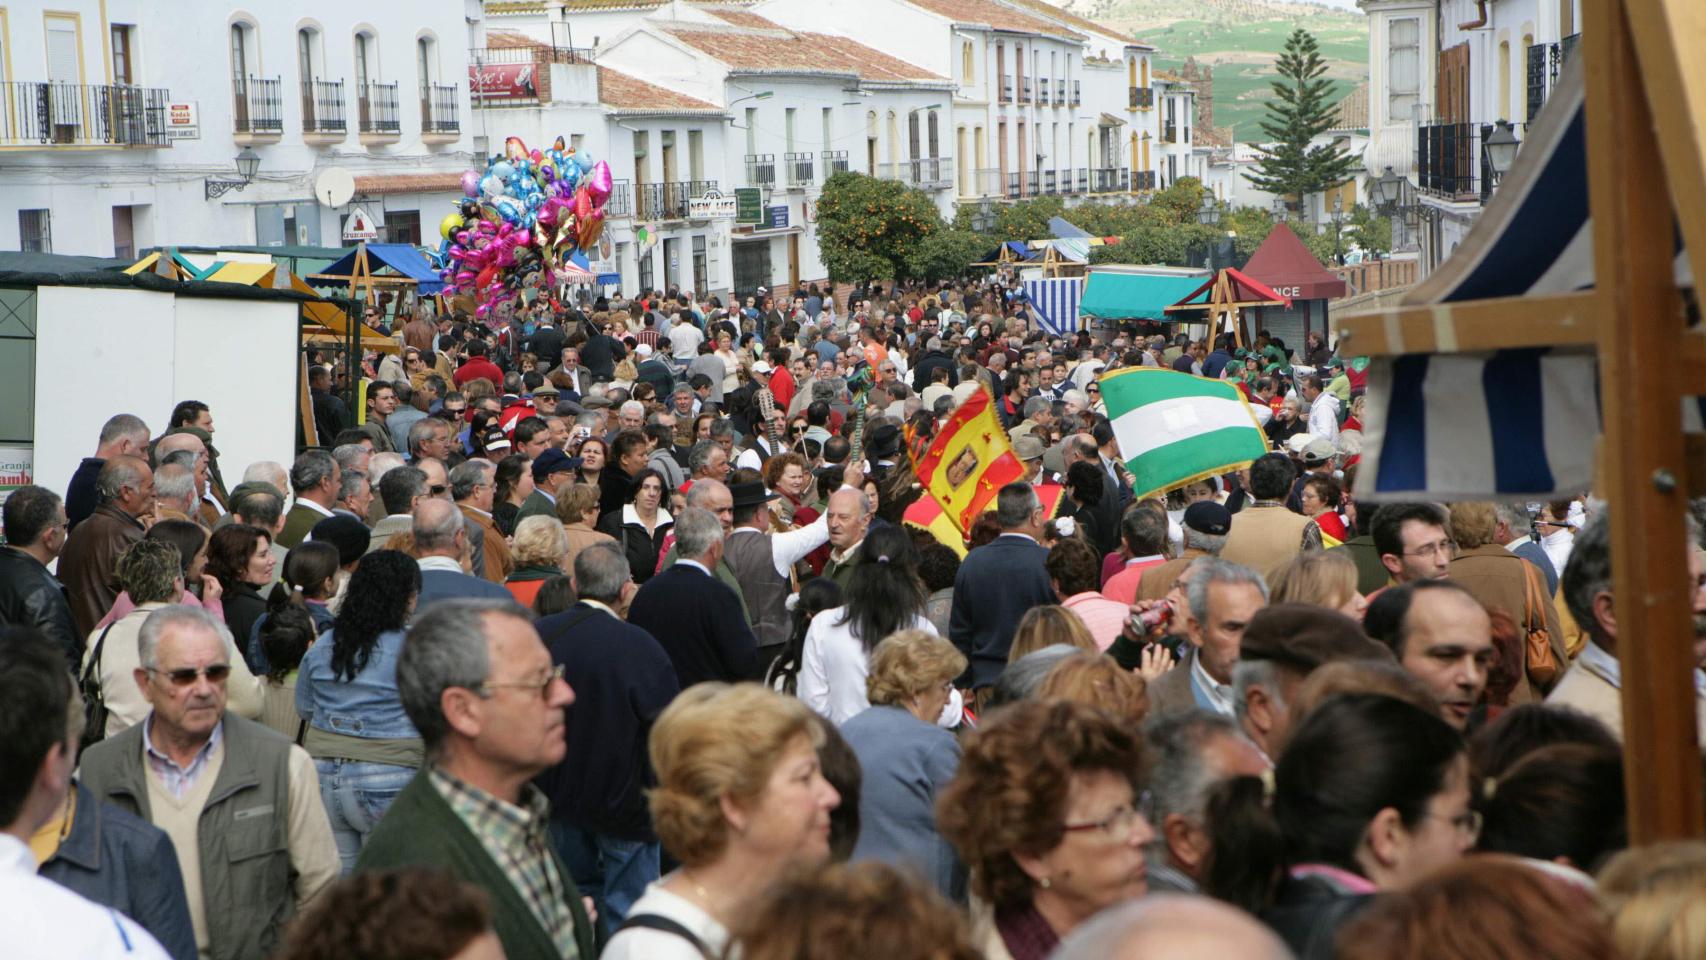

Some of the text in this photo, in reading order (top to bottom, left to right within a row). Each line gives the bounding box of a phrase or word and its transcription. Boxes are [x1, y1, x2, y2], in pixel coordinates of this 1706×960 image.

[704, 191, 721, 200] PUB
[691, 201, 735, 211] NEW LIFE
